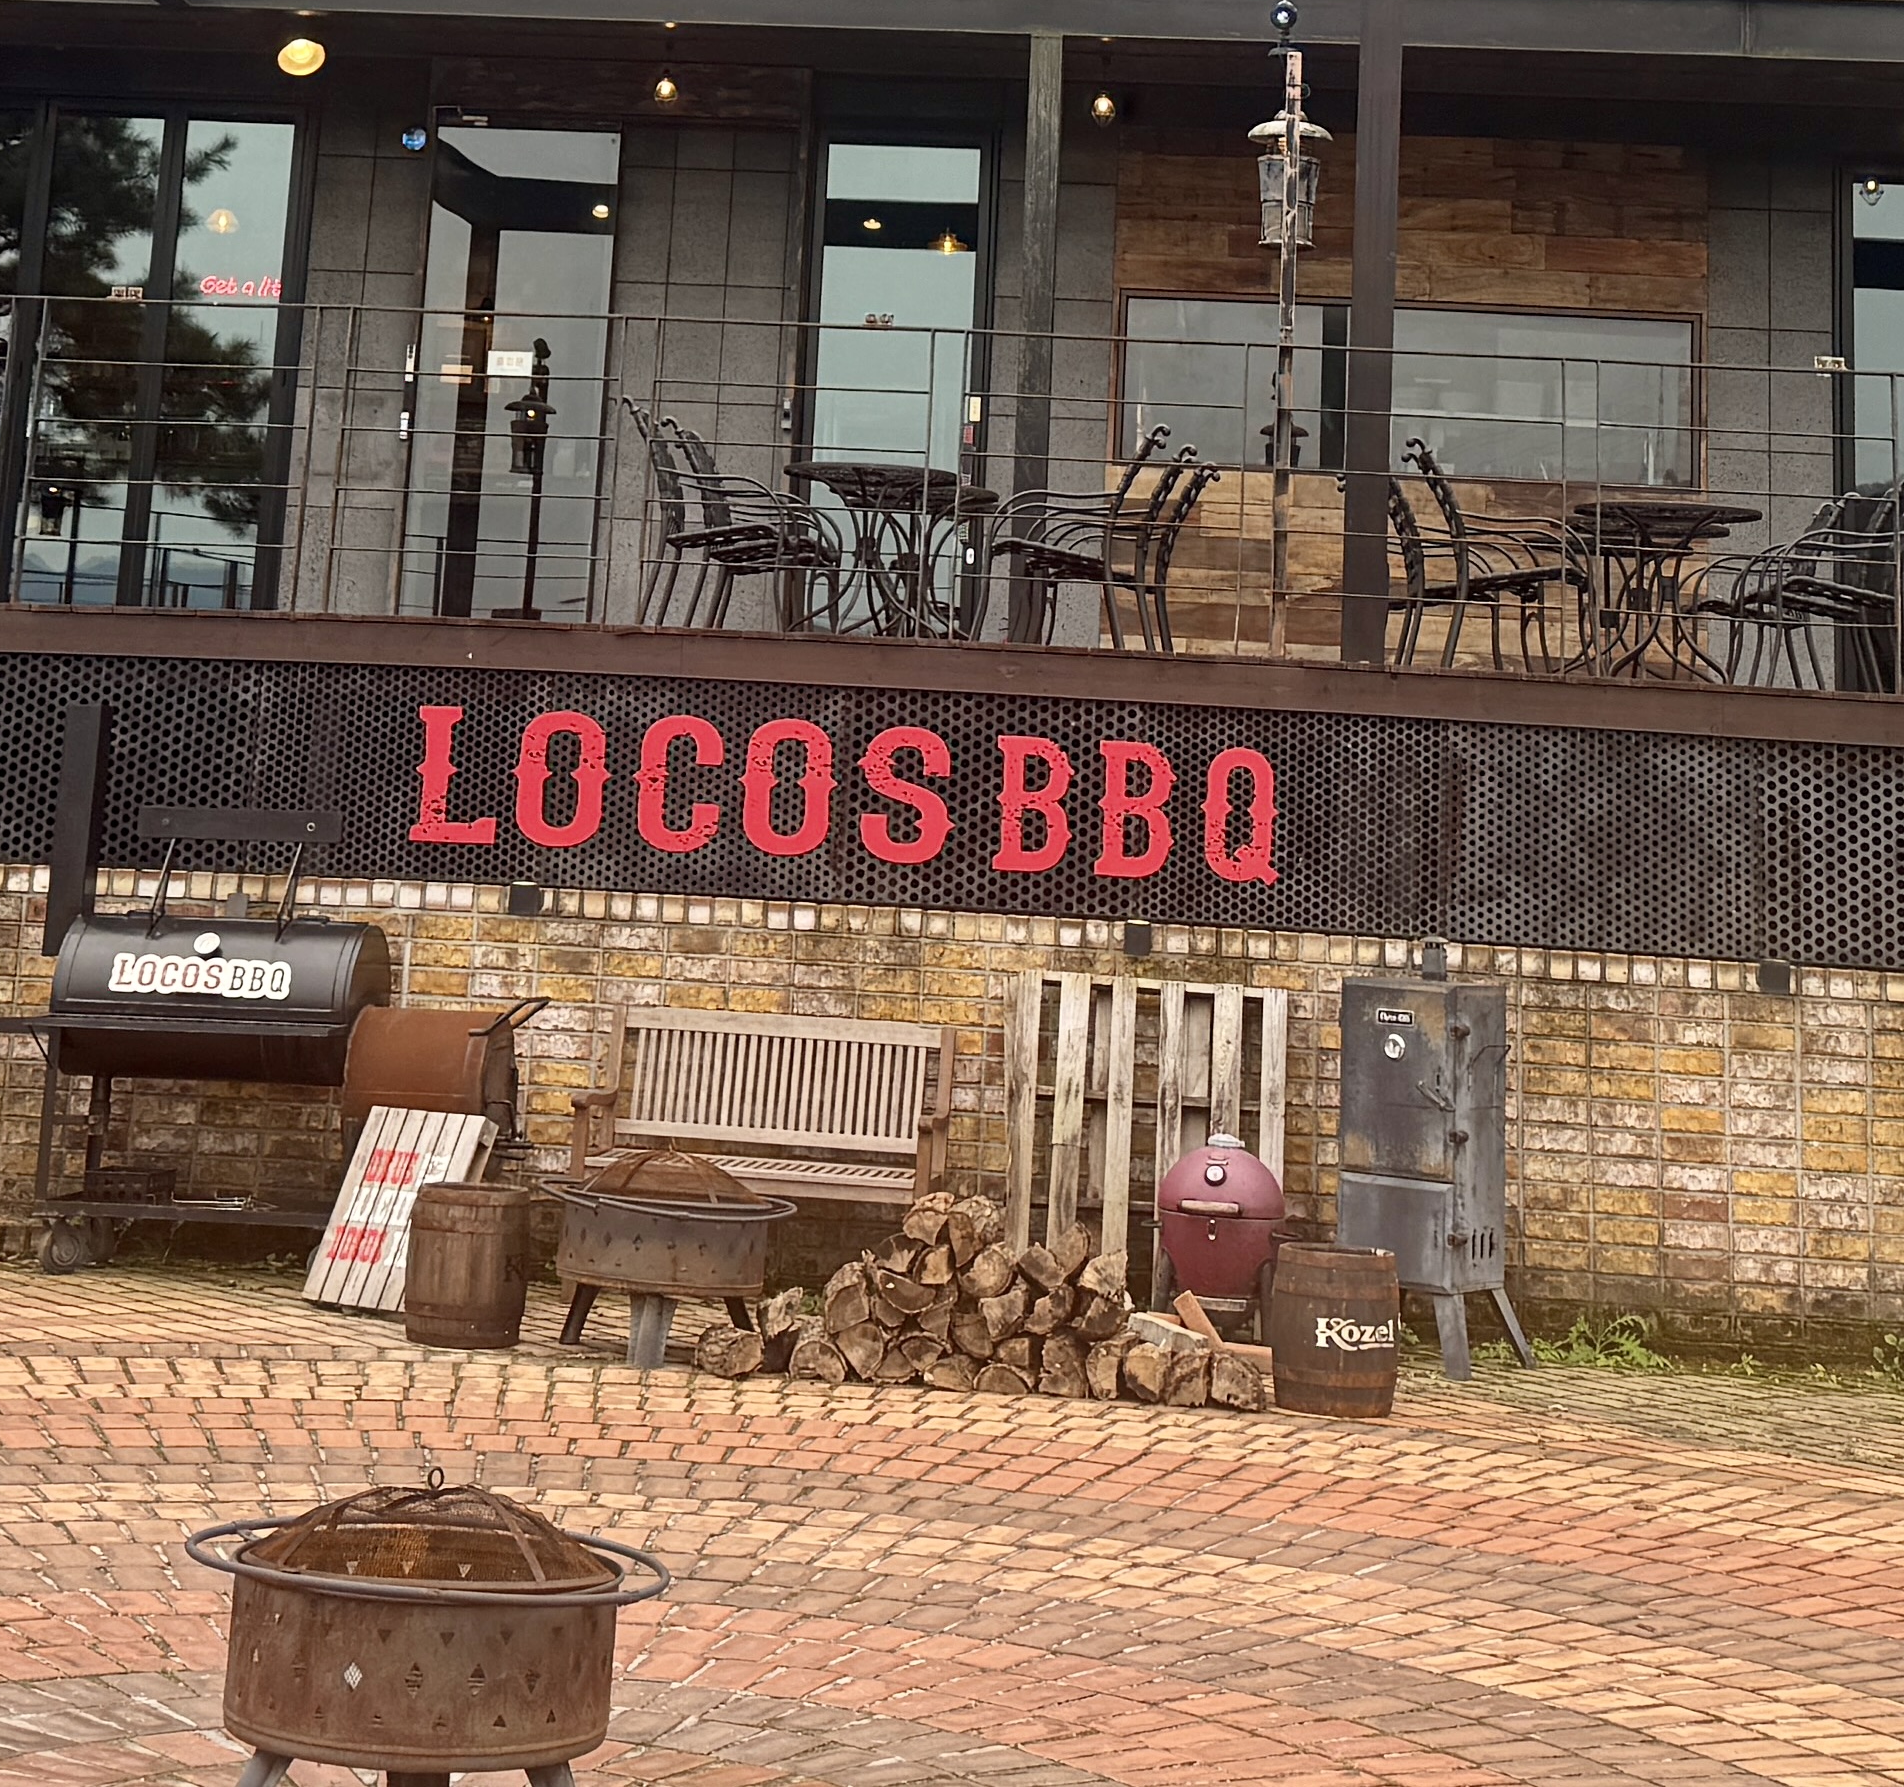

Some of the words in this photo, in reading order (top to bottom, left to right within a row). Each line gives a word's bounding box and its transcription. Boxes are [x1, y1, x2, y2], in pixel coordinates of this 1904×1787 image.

[200, 275, 238, 295] Get
[241, 281, 254, 297] a
[408, 705, 956, 866] LOCOS
[990, 734, 1280, 887] BBQ
[115, 959, 224, 990] LOCOS
[228, 965, 286, 993] BBQ
[1315, 1317, 1395, 1351] Kozel
